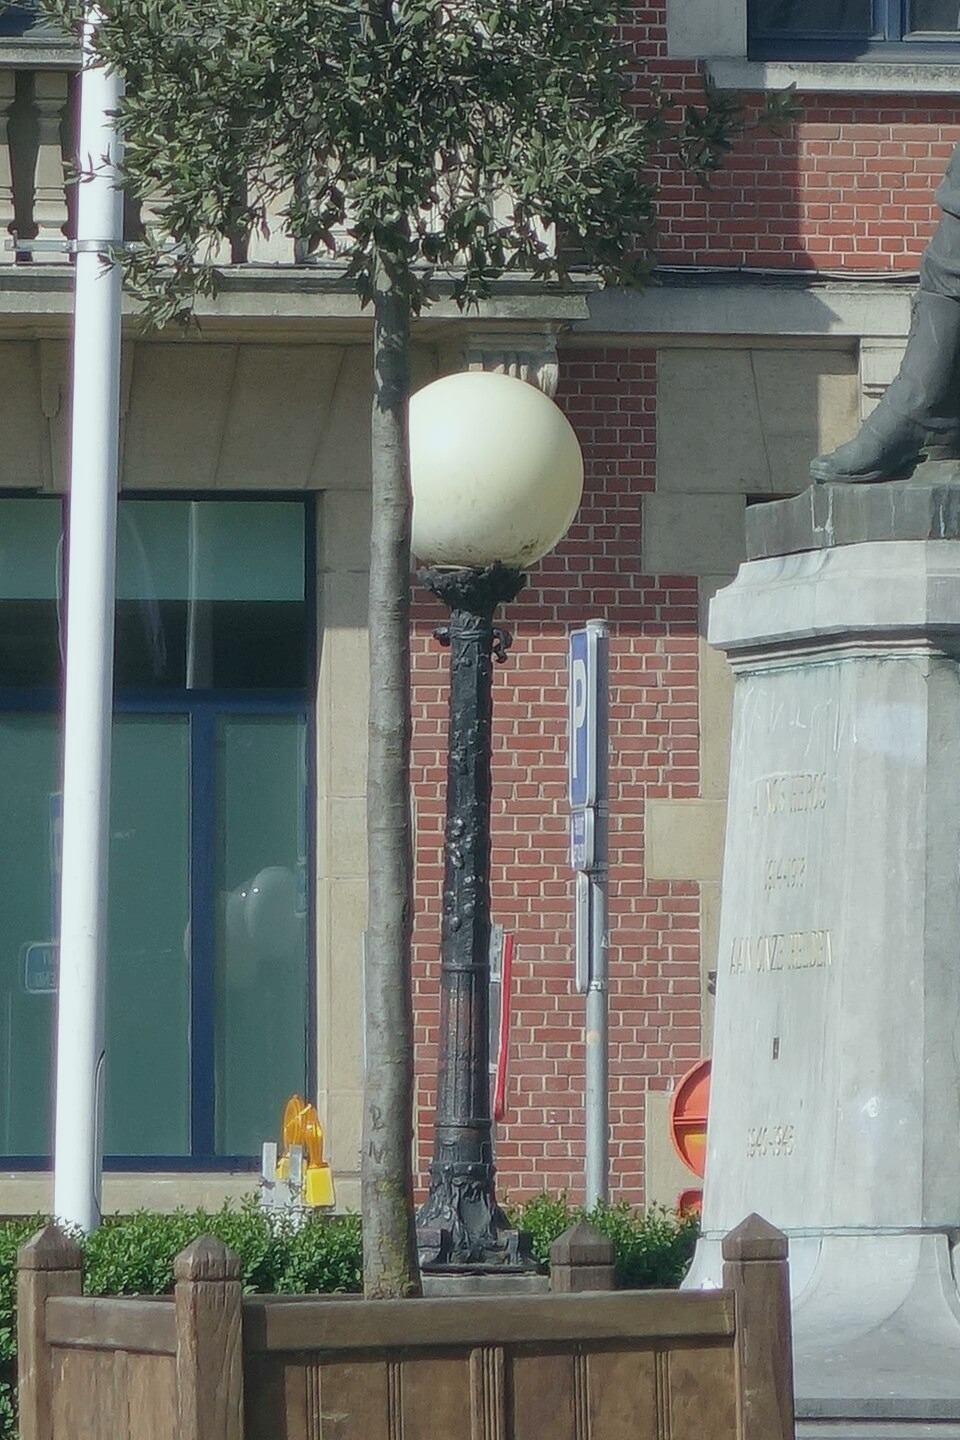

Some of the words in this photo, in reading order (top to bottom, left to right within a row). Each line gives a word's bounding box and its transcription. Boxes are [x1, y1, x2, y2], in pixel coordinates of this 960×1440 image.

[572, 658, 586, 779] P
[730, 937, 751, 976] AAN
[757, 933, 785, 973] ONZE
[787, 928, 833, 970] HELDEN
